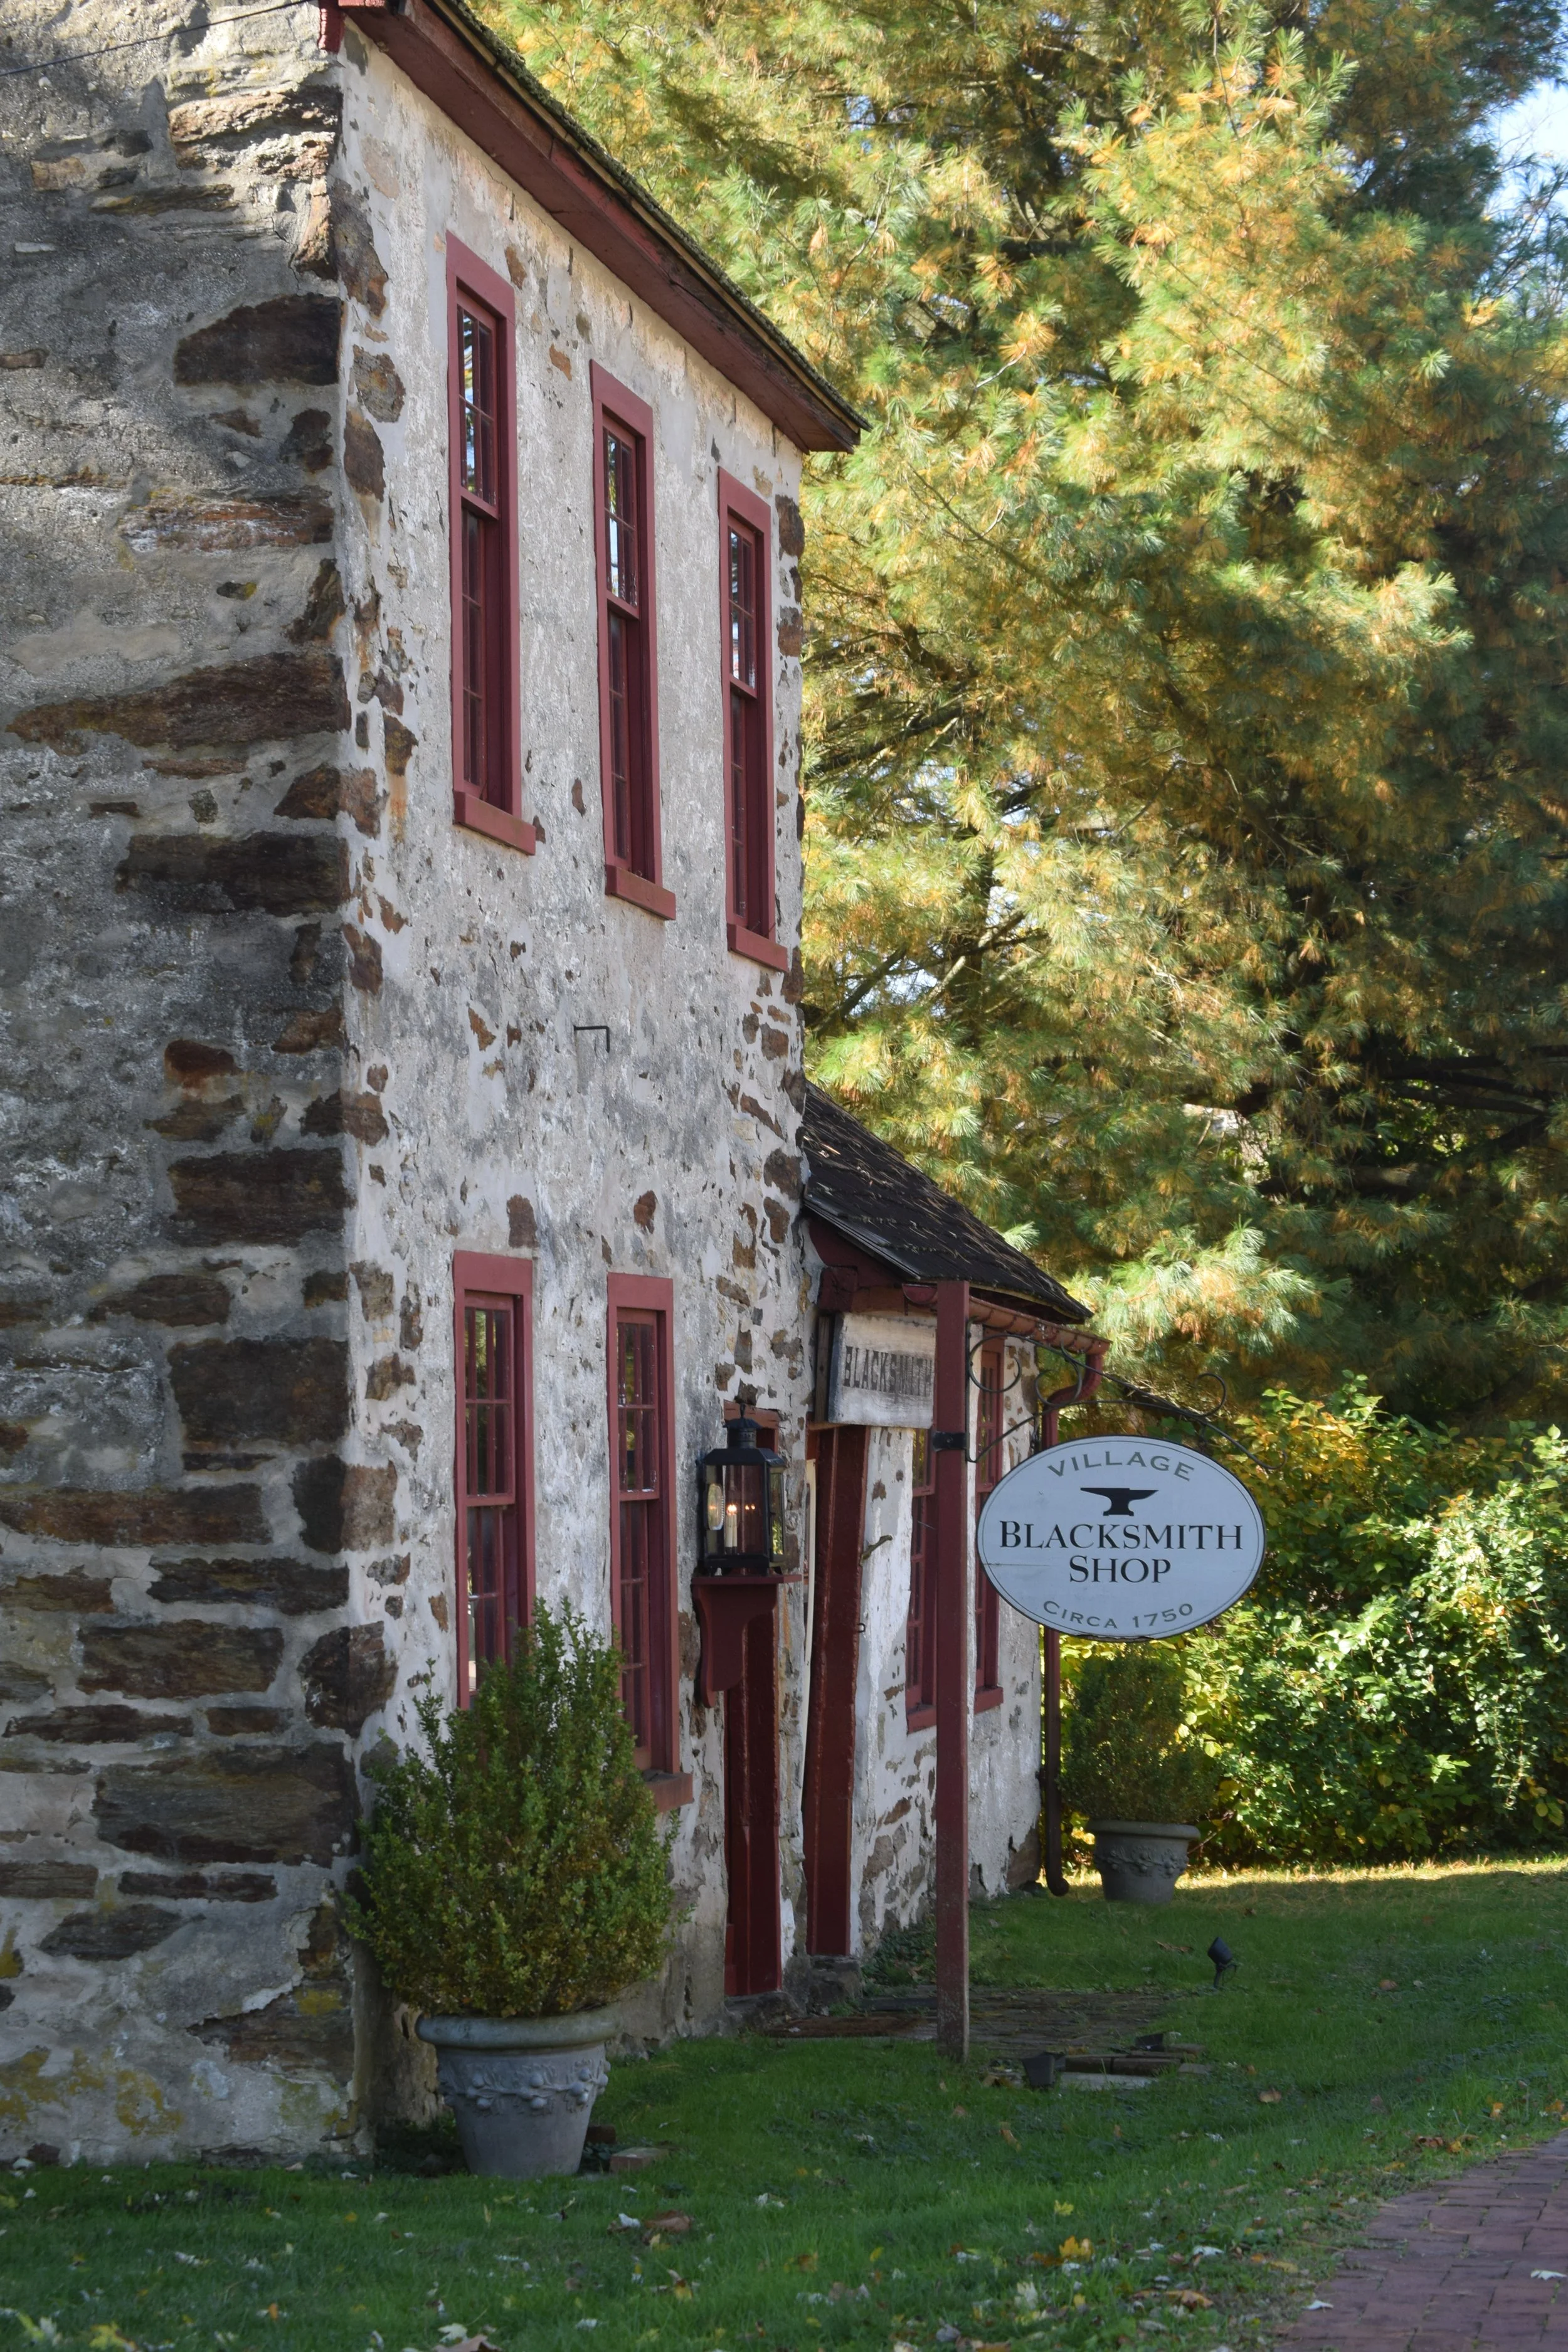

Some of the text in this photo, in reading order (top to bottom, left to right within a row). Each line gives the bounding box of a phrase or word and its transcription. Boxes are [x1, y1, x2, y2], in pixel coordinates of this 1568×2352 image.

[843, 1345, 933, 1397] BLACKSMITH
[1047, 1451, 1194, 1481] VILLAGE
[1000, 1520, 1243, 1550] BLACKSMITH
[1069, 1555, 1171, 1583] SHOP
[1043, 1600, 1194, 1629] CIRCA 1750
